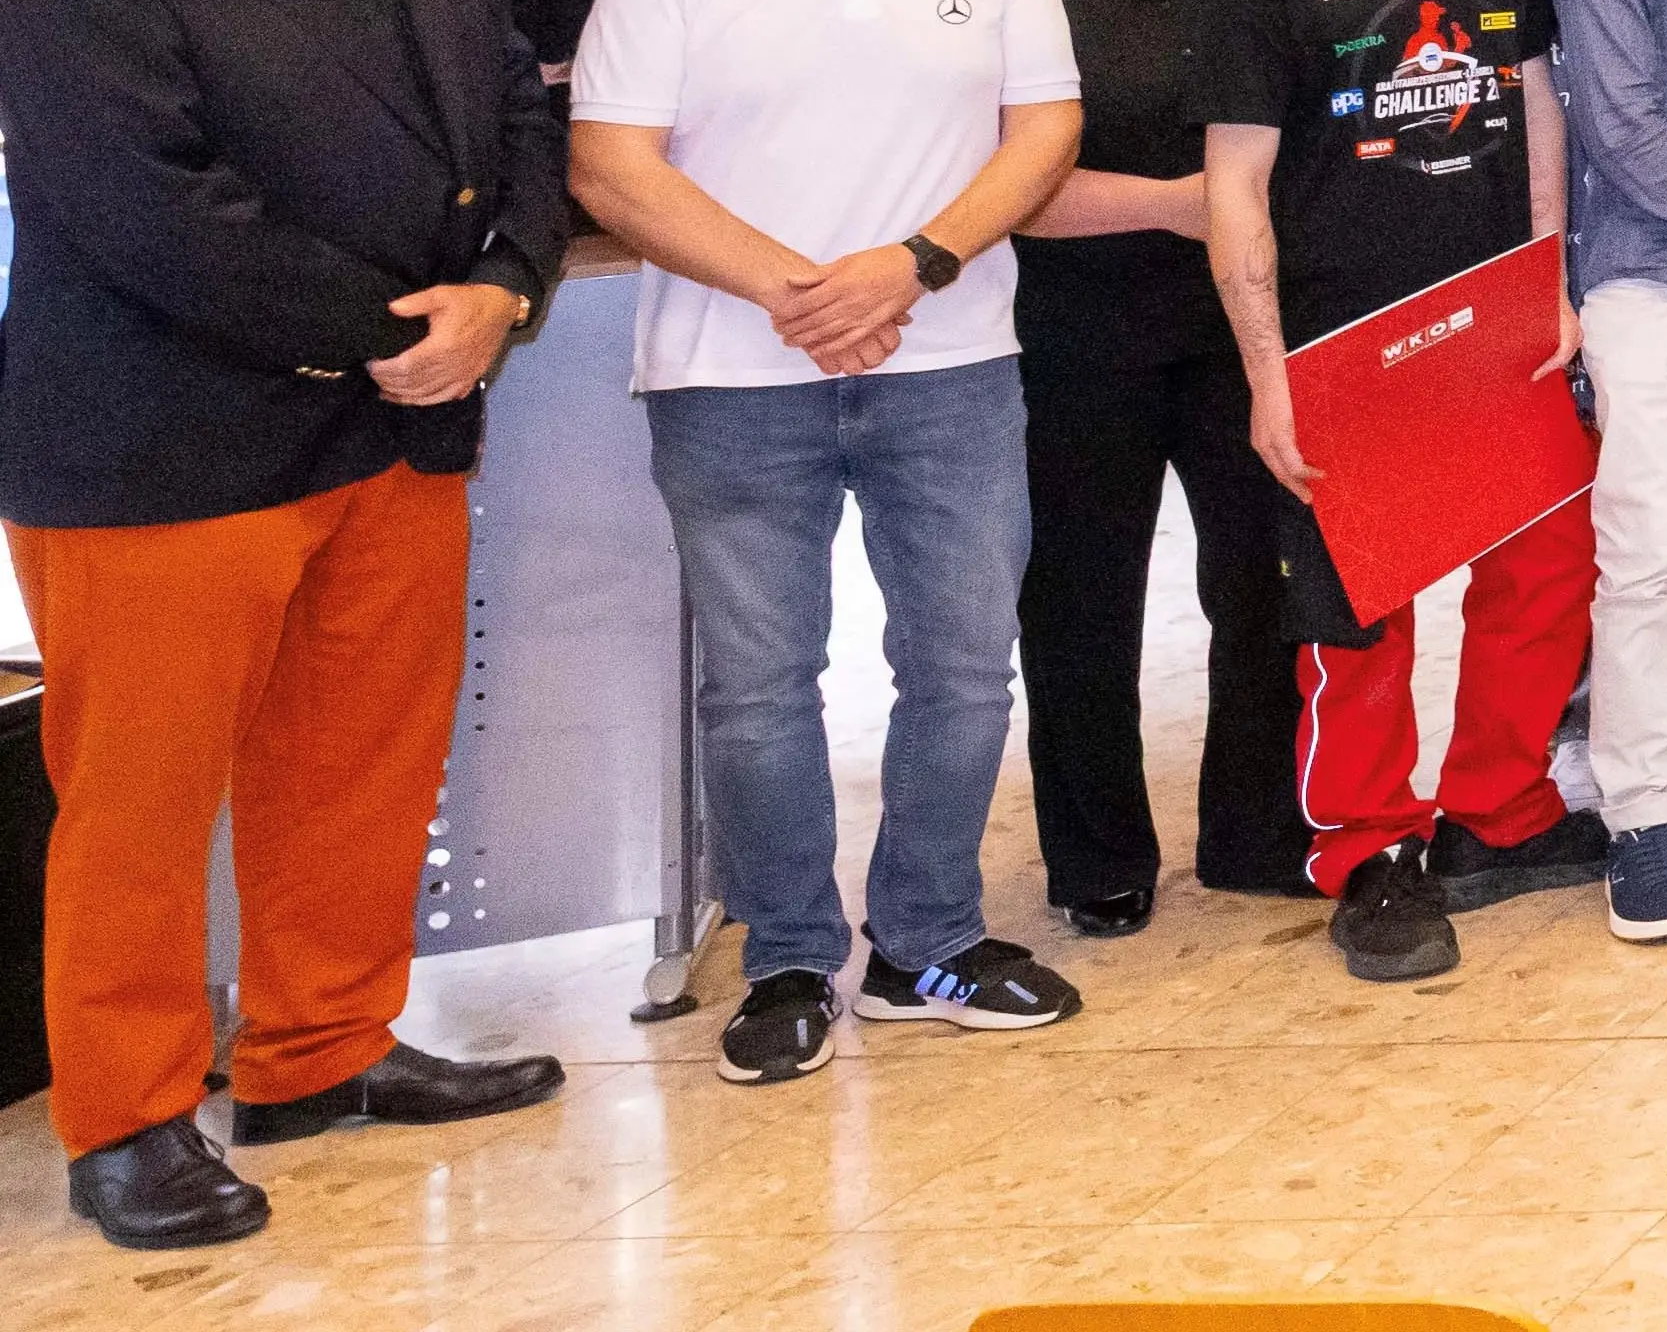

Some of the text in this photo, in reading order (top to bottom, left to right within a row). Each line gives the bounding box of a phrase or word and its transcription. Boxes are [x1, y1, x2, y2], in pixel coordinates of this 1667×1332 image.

[1348, 34, 1386, 53] DEKRA
[1331, 91, 1364, 115] PPG
[1374, 81, 1483, 120] CHALLENGE
[1486, 77, 1500, 102] 2
[1359, 141, 1393, 155] SATA
[1383, 321, 1448, 360] WKO
